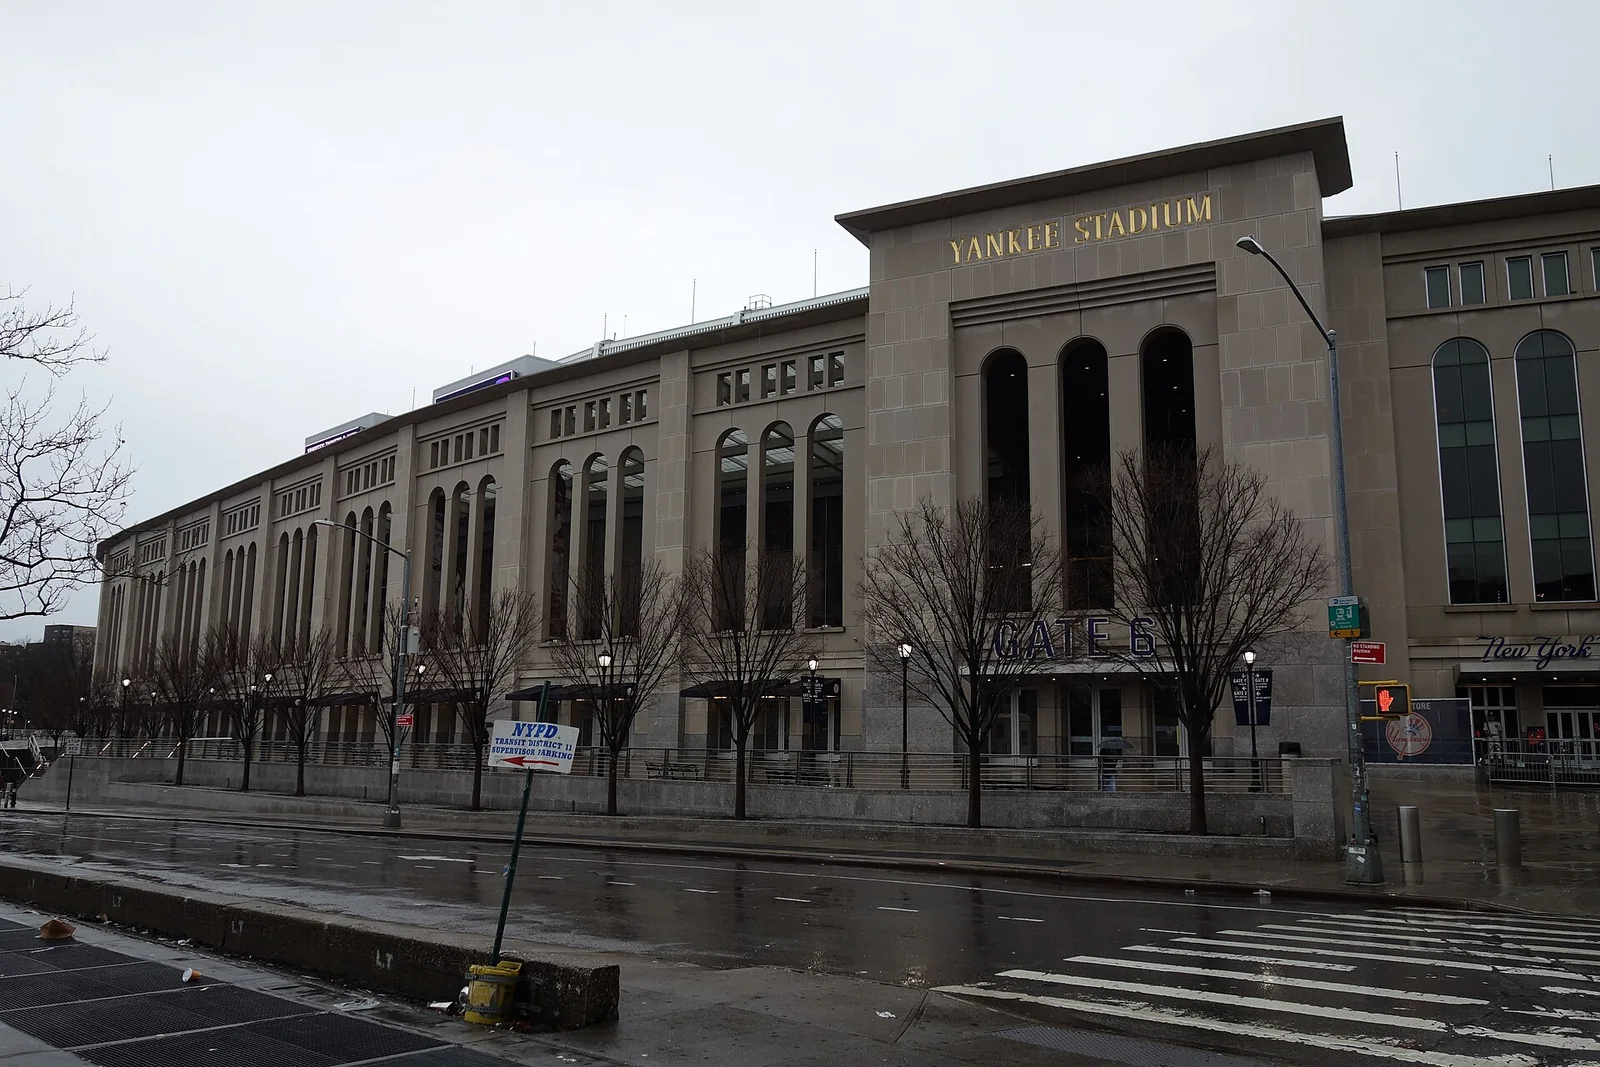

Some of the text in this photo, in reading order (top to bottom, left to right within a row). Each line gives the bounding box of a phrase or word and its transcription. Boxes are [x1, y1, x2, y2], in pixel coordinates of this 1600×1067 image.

[950, 193, 1214, 265] YANKEE STADIUM
[993, 616, 1157, 659] GATE 6
[1476, 634, 1595, 670] New York
[1411, 702, 1432, 710] TORE
[511, 722, 559, 739] NYPD
[491, 746, 536, 756] SUPERVISOR
[495, 737, 573, 751] TRANSIT DISTRICT 11
